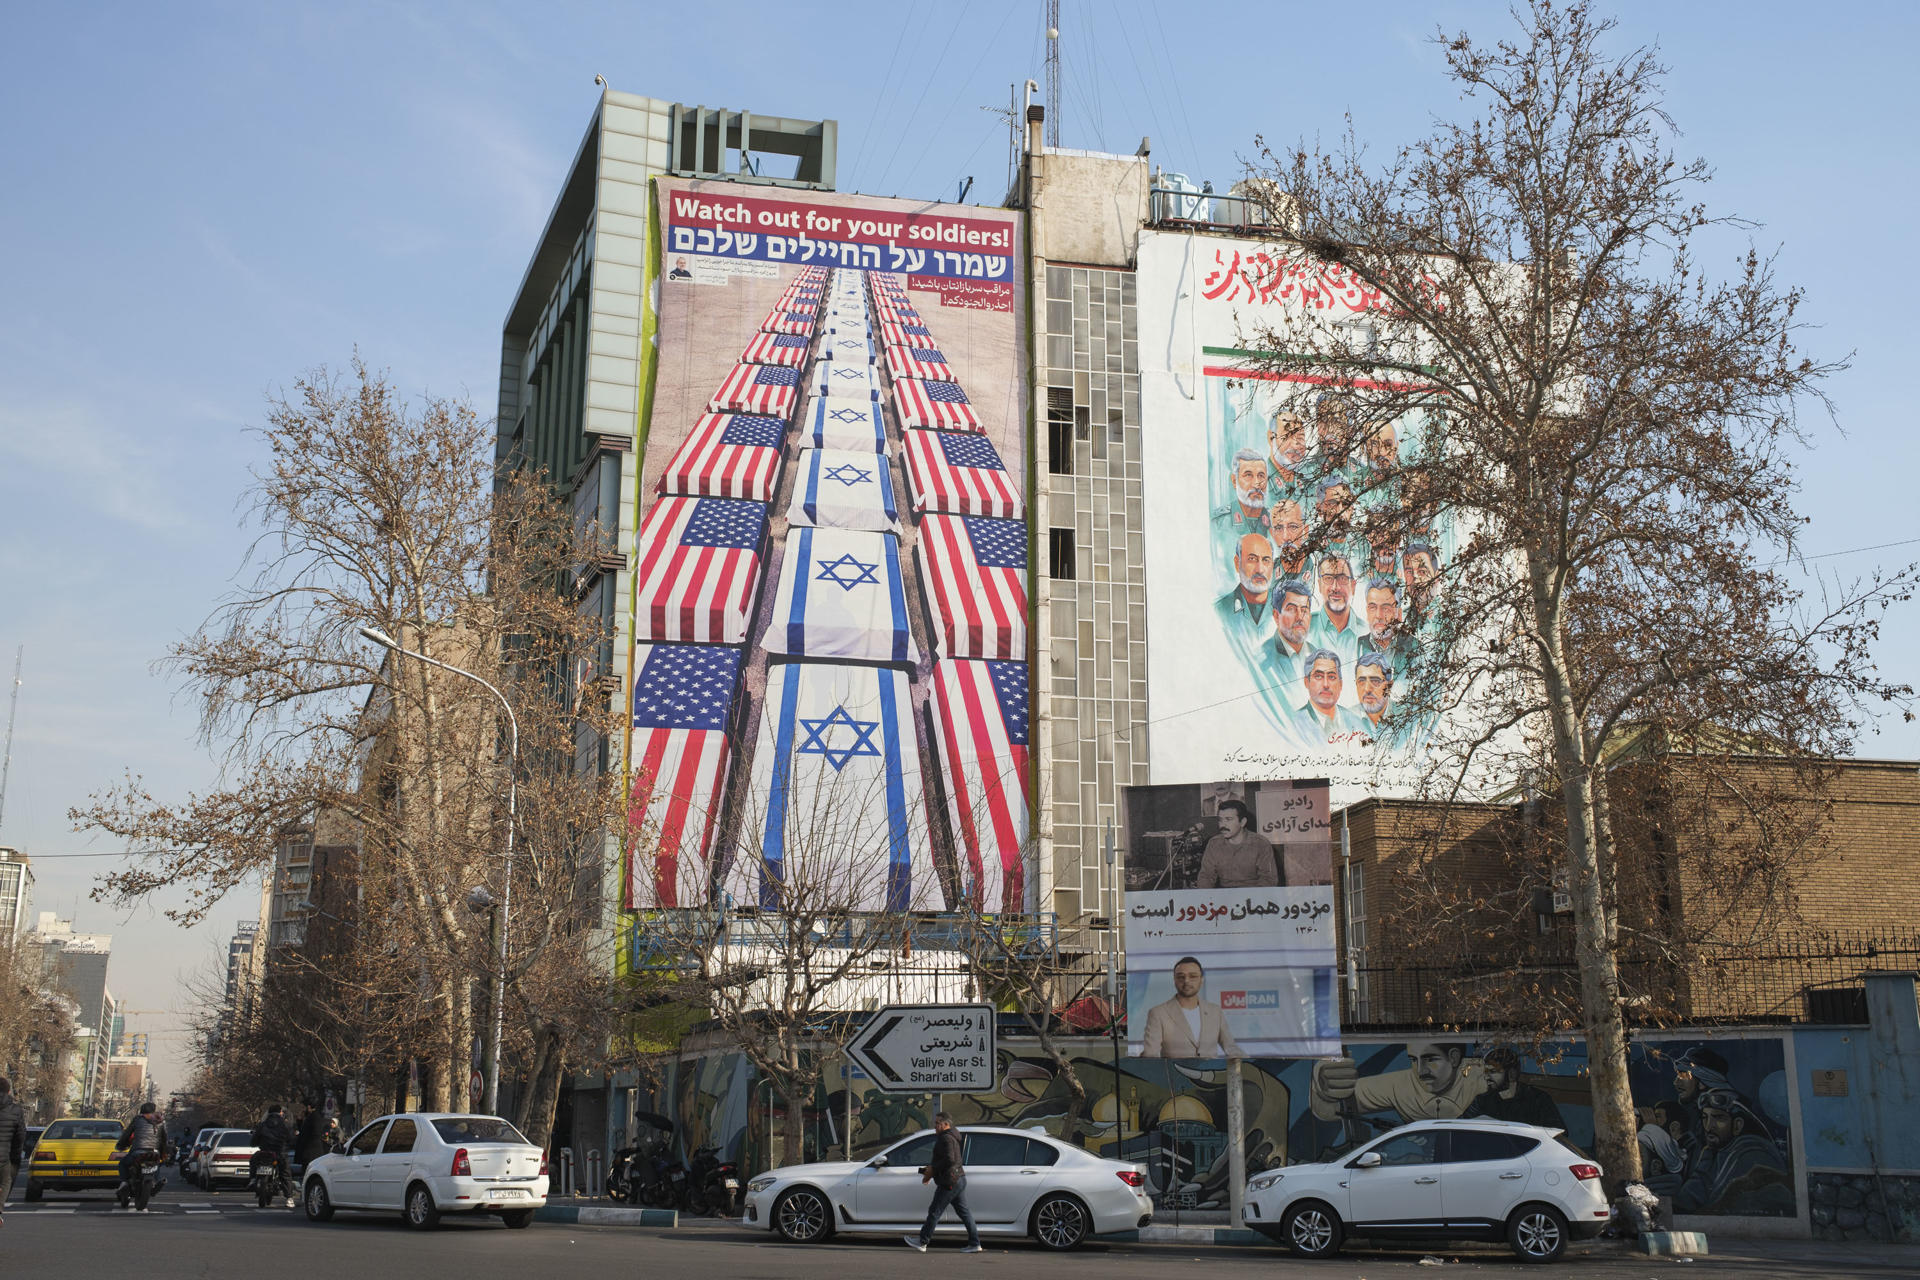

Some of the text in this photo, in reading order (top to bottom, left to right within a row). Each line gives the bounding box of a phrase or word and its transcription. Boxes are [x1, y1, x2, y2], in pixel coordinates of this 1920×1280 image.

[674, 197, 1010, 248] Watch out for your soldiers!
[674, 224, 758, 257] שלכם
[767, 232, 882, 269] החיילים
[888, 241, 927, 273] על
[933, 250, 1007, 278] שמרו
[912, 276, 1010, 297] مراقب سربازانتان باشید!
[1262, 753, 1280, 766] اسلامی
[1280, 755, 1300, 767] جمهوری
[1301, 755, 1316, 767] برای
[1282, 794, 1313, 810] رادیو
[1262, 816, 1298, 833] آزادی
[1131, 898, 1331, 922] مزدور همان مزدور است
[923, 1014, 973, 1031] ولیعصر
[920, 1034, 973, 1053] شریعتی
[911, 1056, 987, 1070] Valiye Asr St.
[910, 1072, 976, 1083] Shari'ati St.
